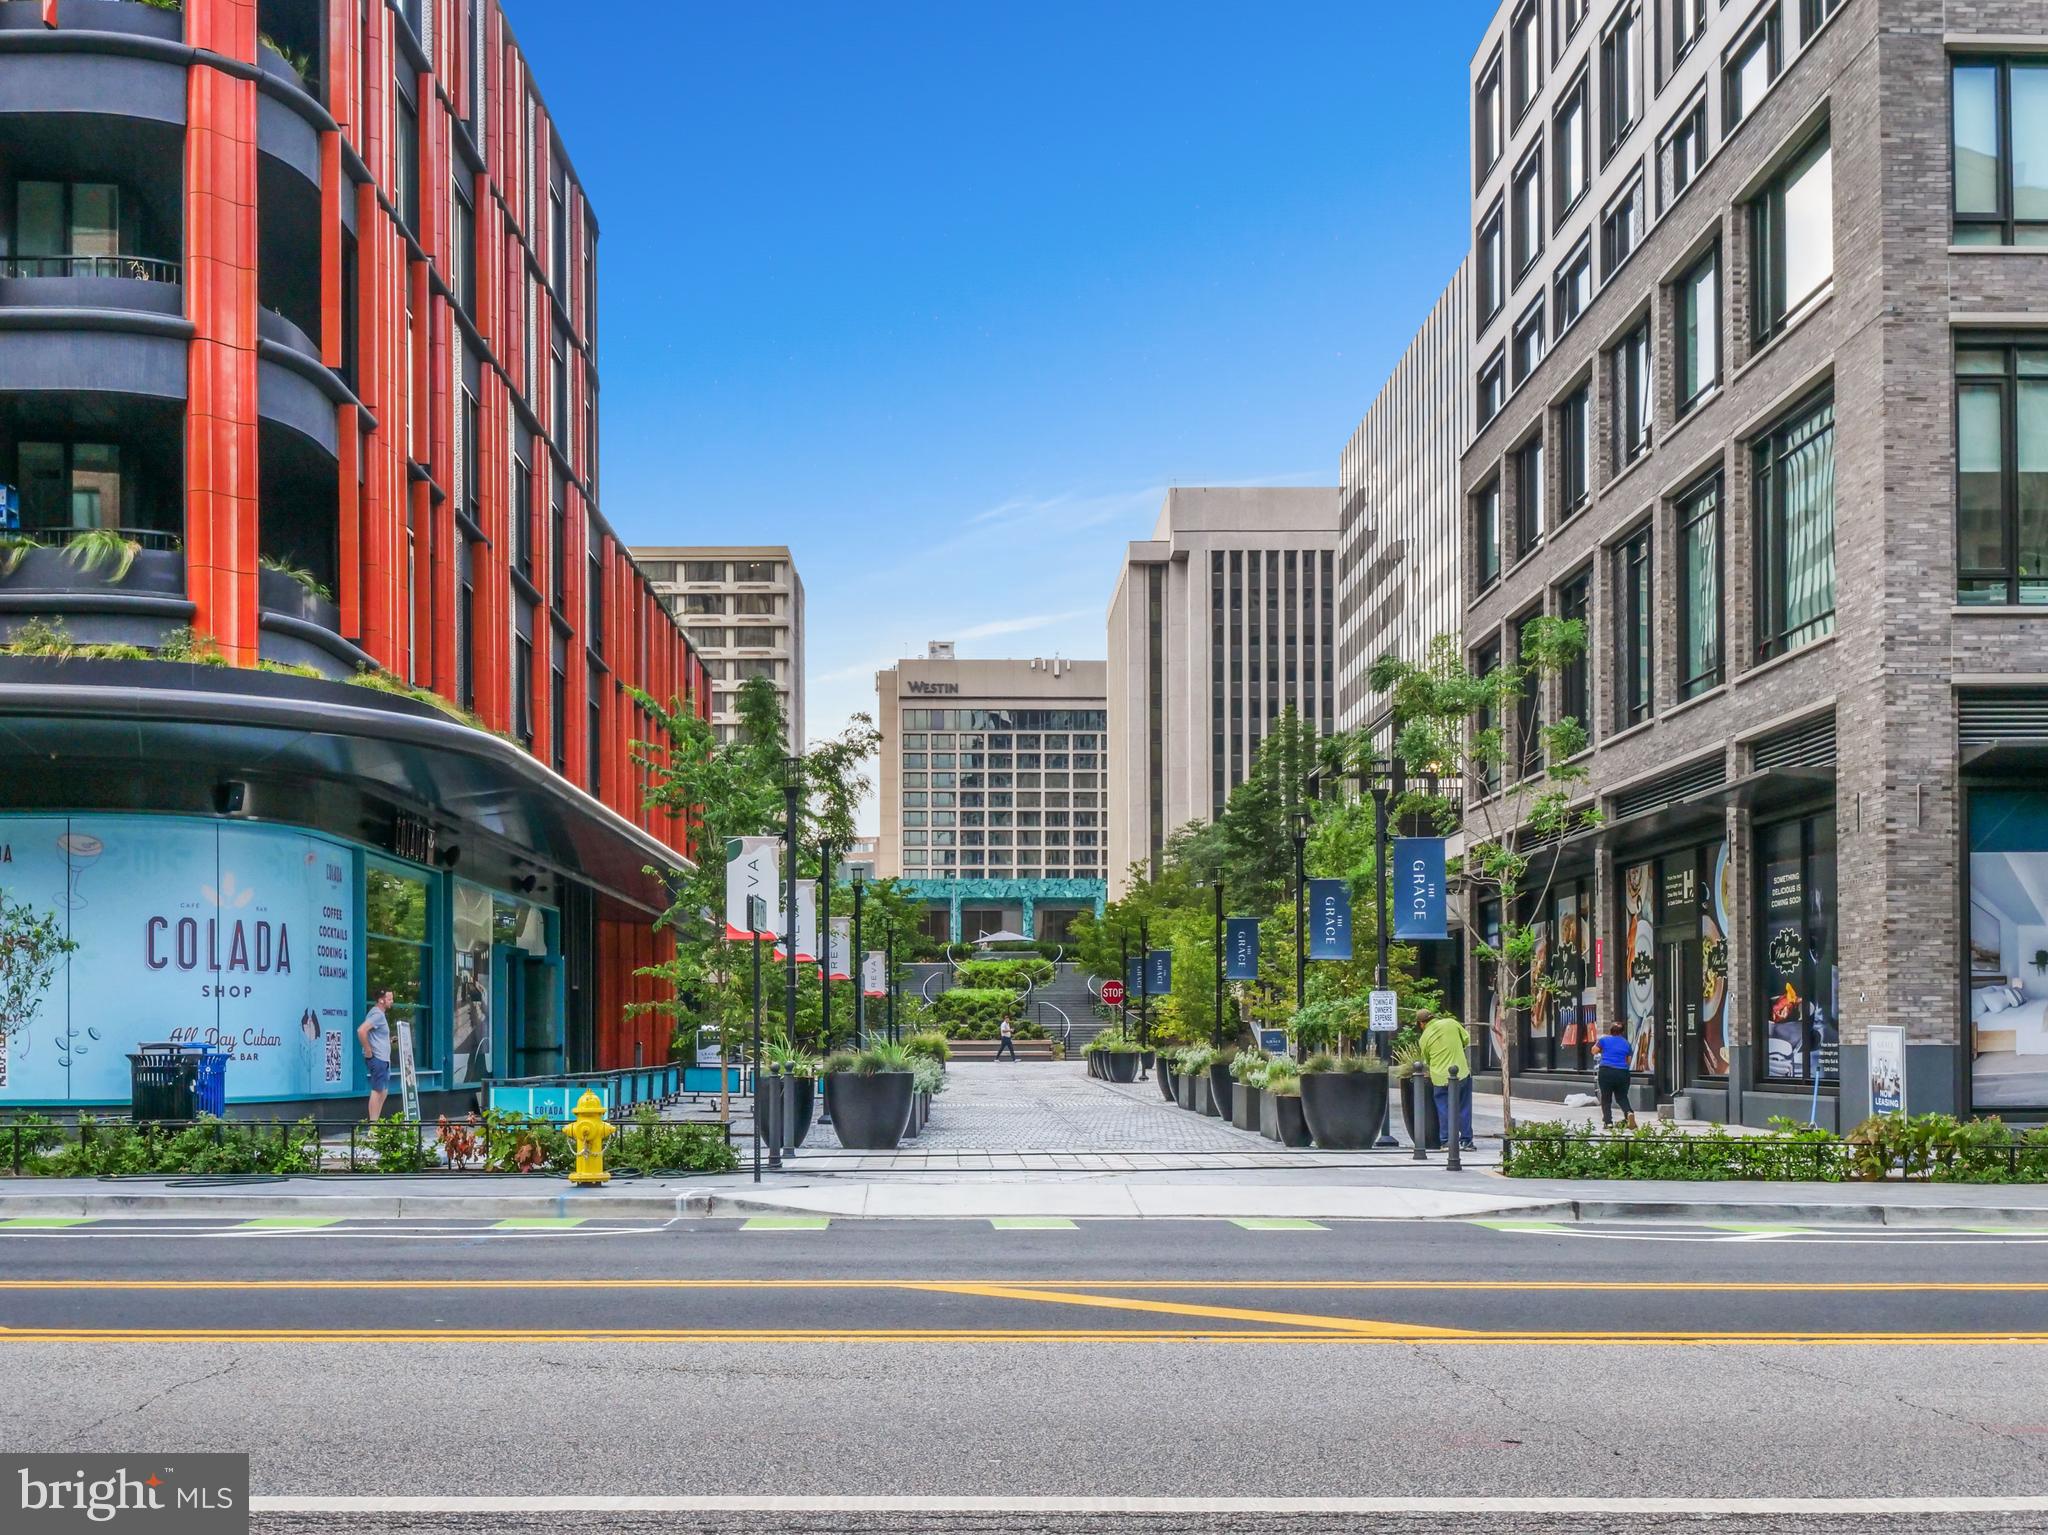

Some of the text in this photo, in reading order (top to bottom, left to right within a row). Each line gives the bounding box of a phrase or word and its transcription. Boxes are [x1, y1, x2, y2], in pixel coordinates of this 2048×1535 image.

[907, 681, 958, 693] WESTIN
[748, 858, 759, 888] VA
[1773, 872, 1799, 884] SOMETHING
[1412, 860, 1426, 920] GRACE
[1772, 884, 1795, 896] DELICIOUS
[1771, 898, 1788, 908] COMING
[323, 906, 342, 921] COFFEE
[1325, 896, 1336, 944] GRACE
[319, 925, 348, 941] COCKTAILS
[146, 916, 292, 975] COLADA
[1238, 931, 1246, 967] GRACE
[317, 945, 342, 960] COOKING
[319, 967, 348, 980] CUBANISM!
[202, 985, 252, 998] SHOP
[1103, 988, 1124, 998] STOP
[169, 1027, 282, 1053] All Day Cuban
[240, 1053, 259, 1061] BAR
[1879, 1089, 1892, 1098] NOW
[1875, 1098, 1899, 1108] LEASING
